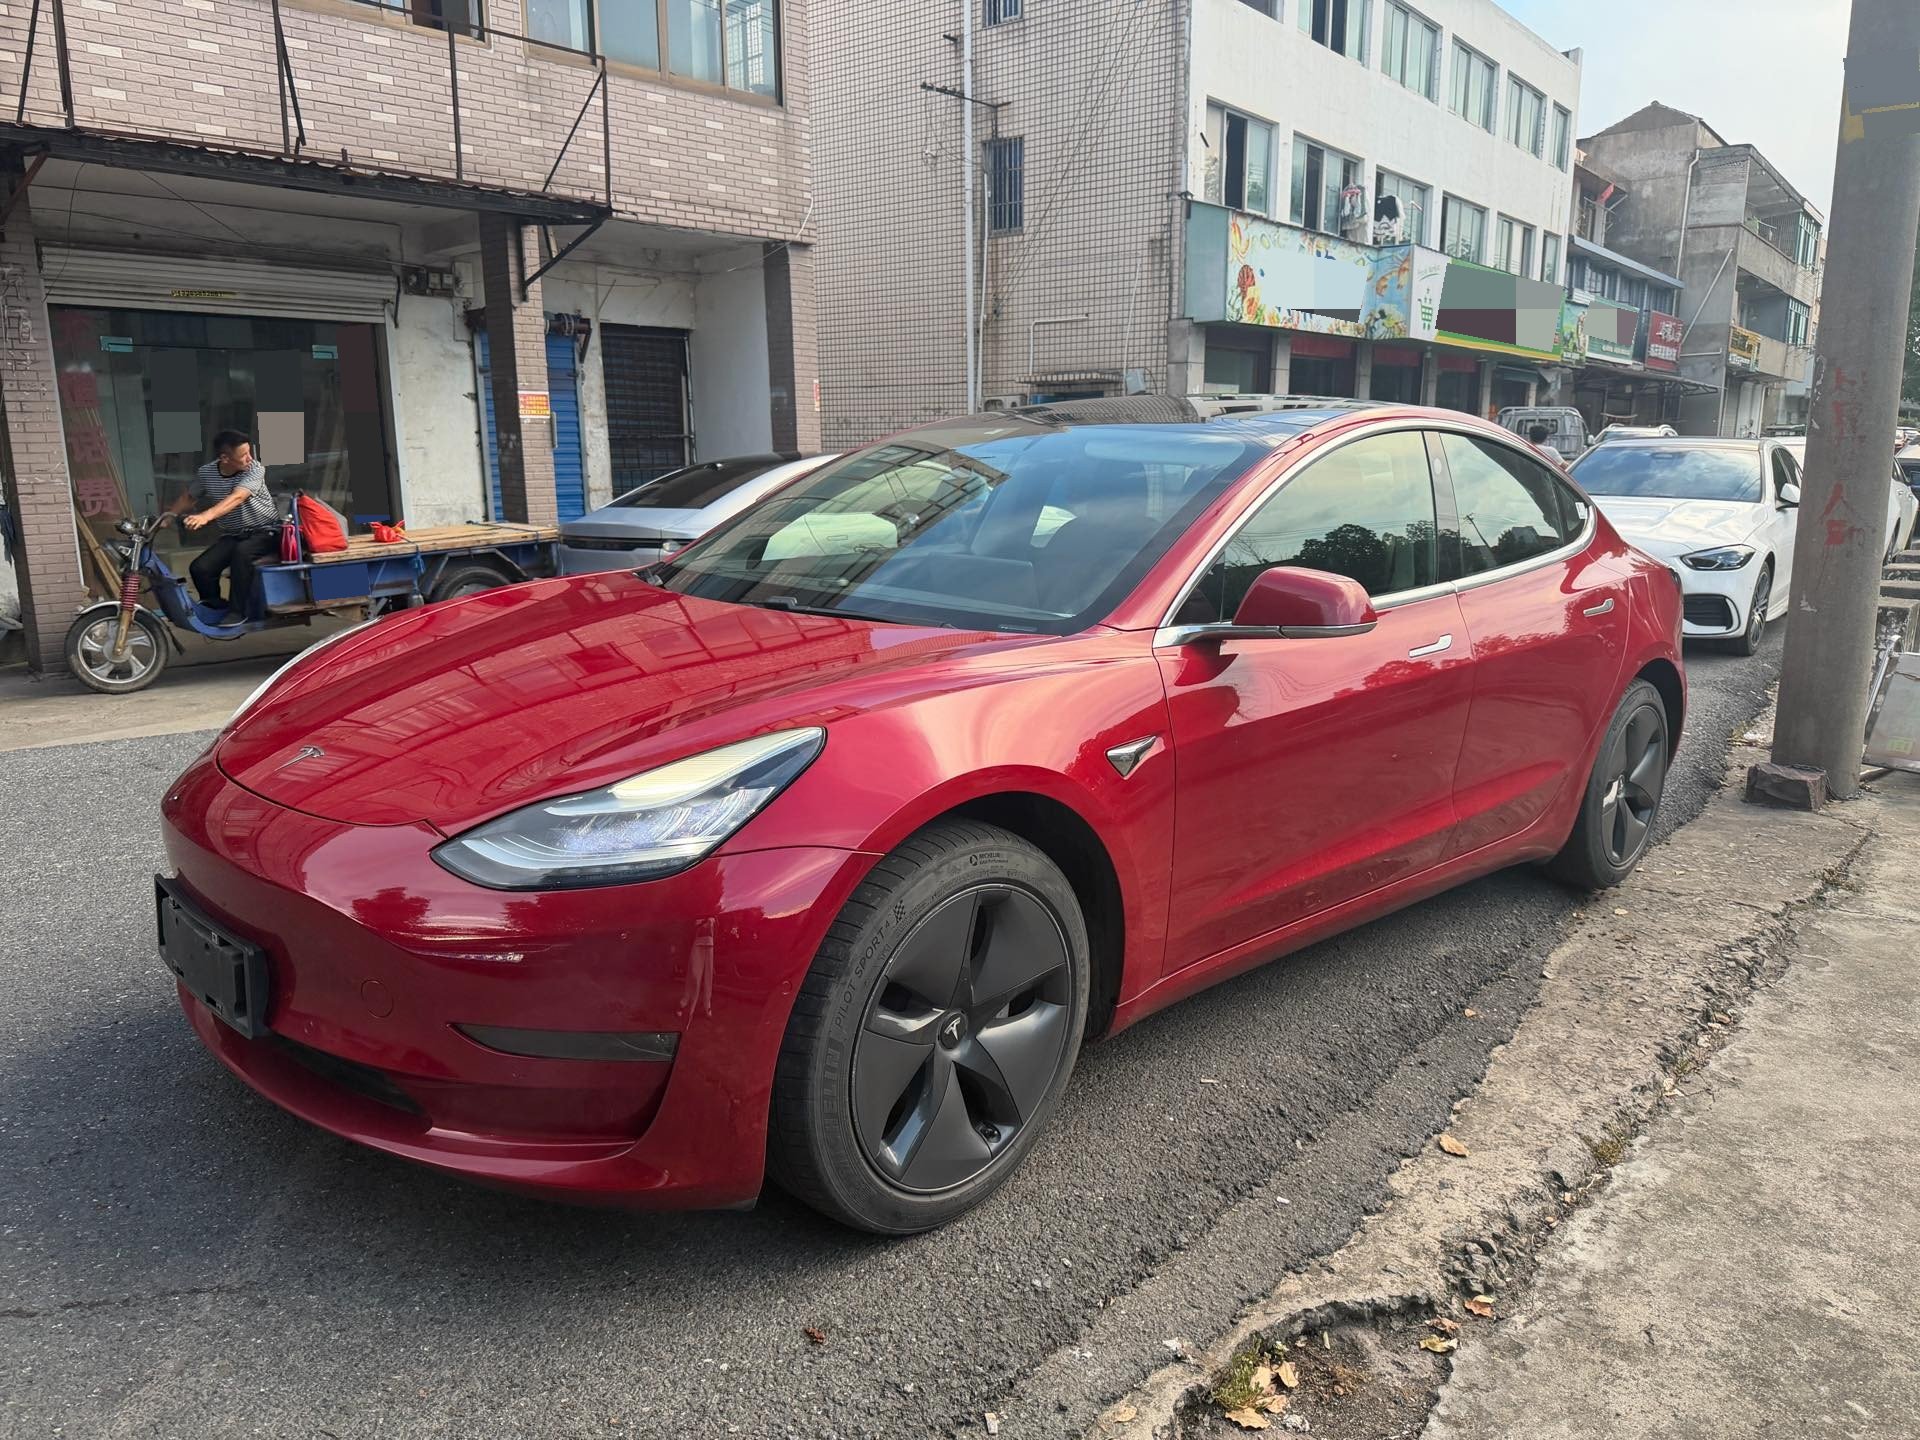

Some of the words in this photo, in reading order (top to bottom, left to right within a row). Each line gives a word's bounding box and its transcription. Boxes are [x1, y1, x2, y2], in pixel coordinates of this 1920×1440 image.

[855, 928, 886, 978] SPORT
[835, 980, 858, 1030] PILOT
[824, 1047, 851, 1169] HELIN
